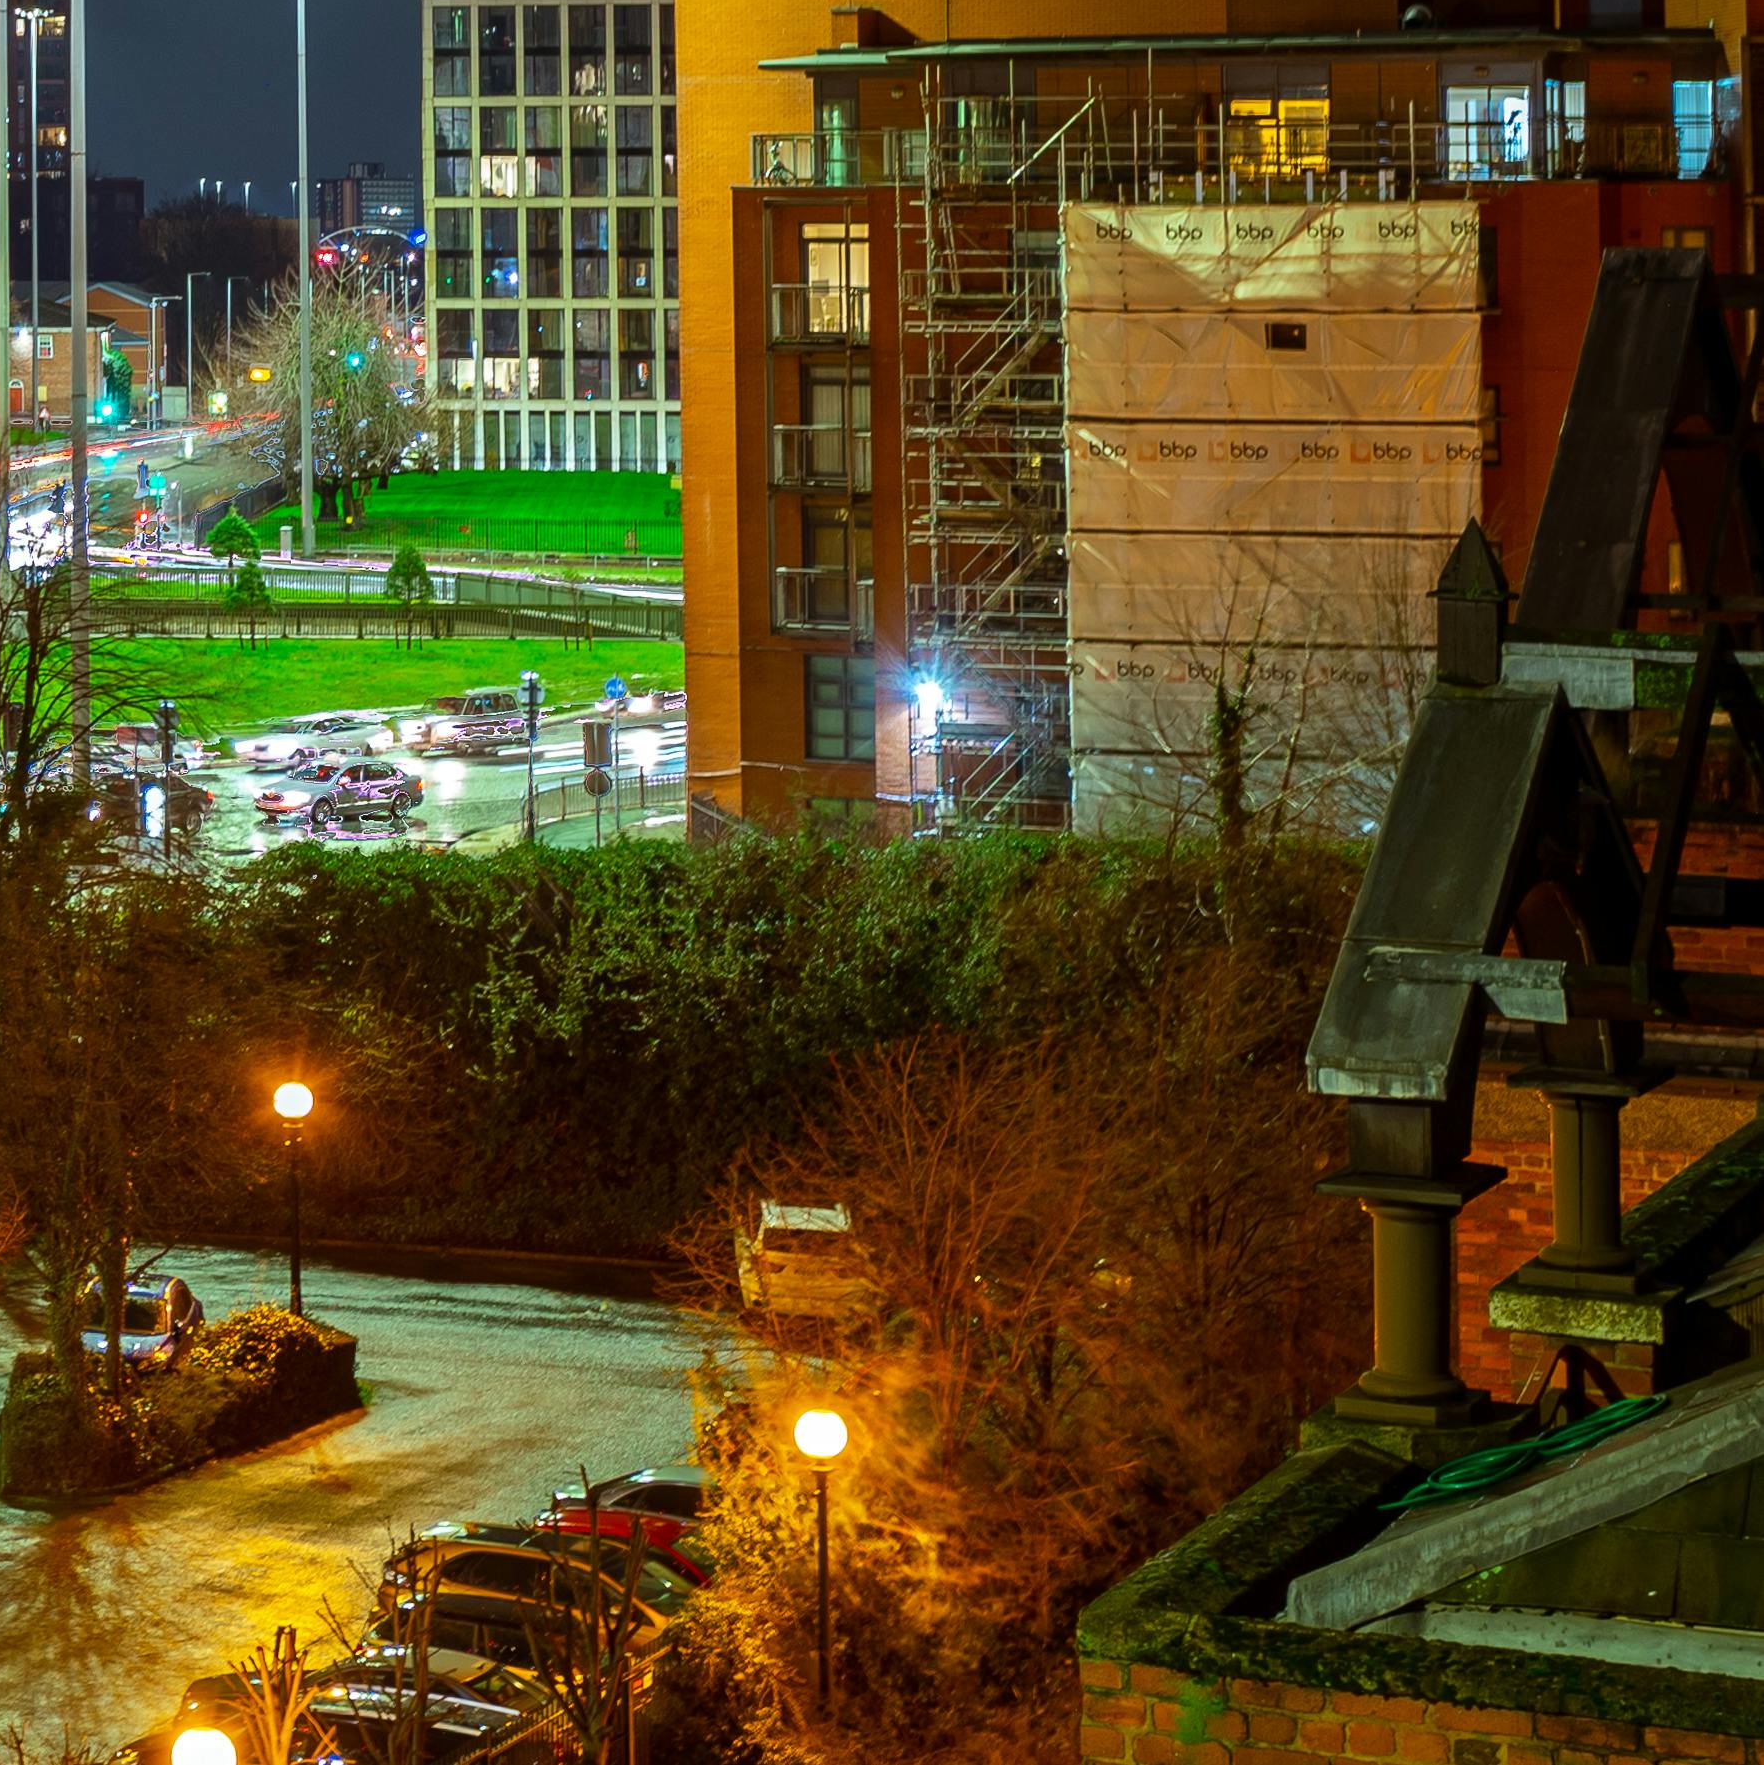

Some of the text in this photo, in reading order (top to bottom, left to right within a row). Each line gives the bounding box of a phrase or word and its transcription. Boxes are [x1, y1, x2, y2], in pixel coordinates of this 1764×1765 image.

[1096, 222, 1133, 241] bbp
[1166, 222, 1203, 241] bbp
[1235, 221, 1274, 241] bbp
[1307, 221, 1344, 240] bbp
[1378, 221, 1417, 239] bbp
[1089, 439, 1483, 462] bbp bbp bbp bbp bbp bbp
[1116, 660, 1155, 678] bbp
